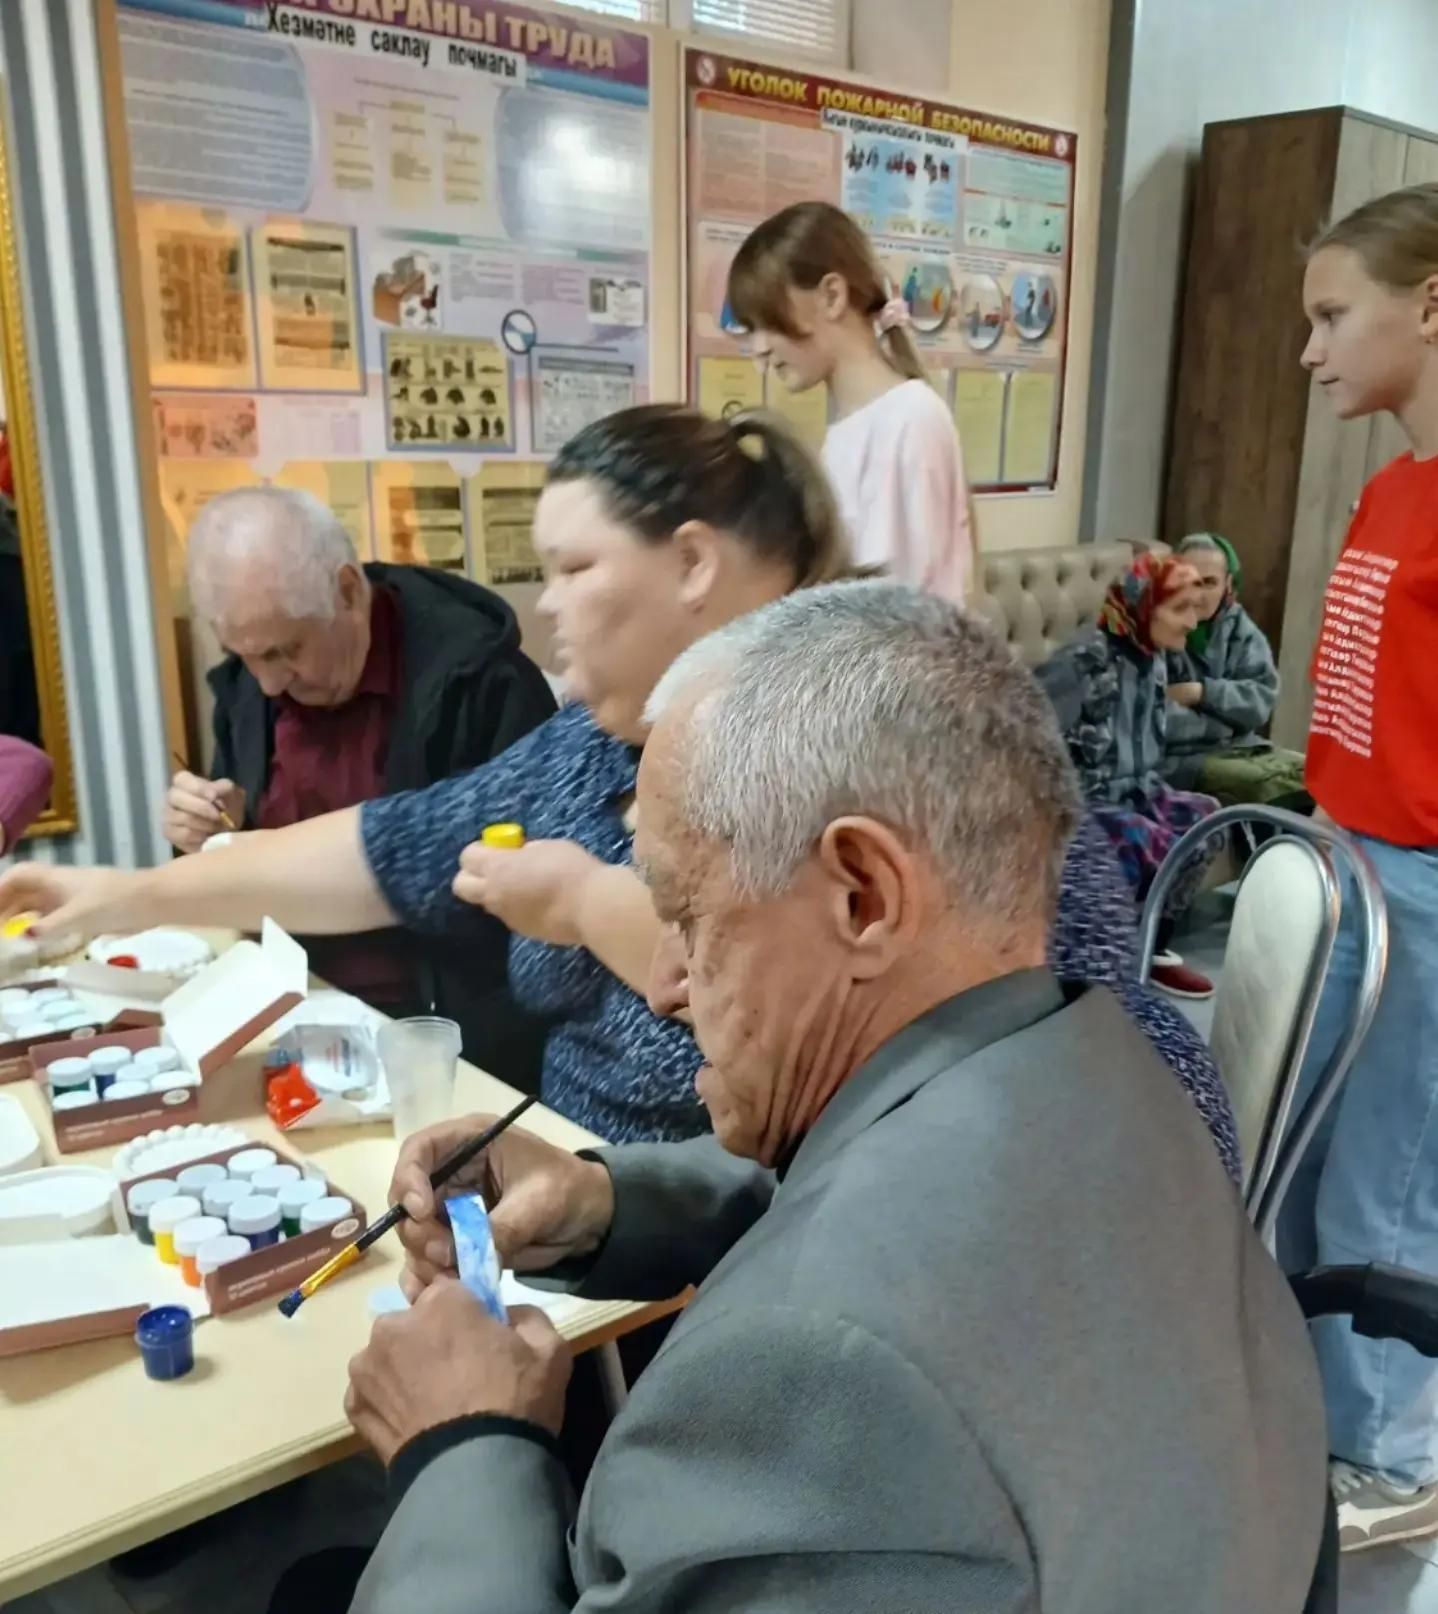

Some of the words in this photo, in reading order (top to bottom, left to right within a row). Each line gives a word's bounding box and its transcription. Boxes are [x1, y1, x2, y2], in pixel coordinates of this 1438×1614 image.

[266, 2, 356, 47] Хезмәтне
[371, 29, 430, 68] саклау
[448, 43, 516, 78] почмагы
[505, 16, 617, 69] ТРУДА
[727, 67, 809, 102] УГОЛОК
[816, 86, 925, 126] ПОЖАРНОЙ
[931, 110, 1050, 151] БЕЗОПАСНОСТИ
